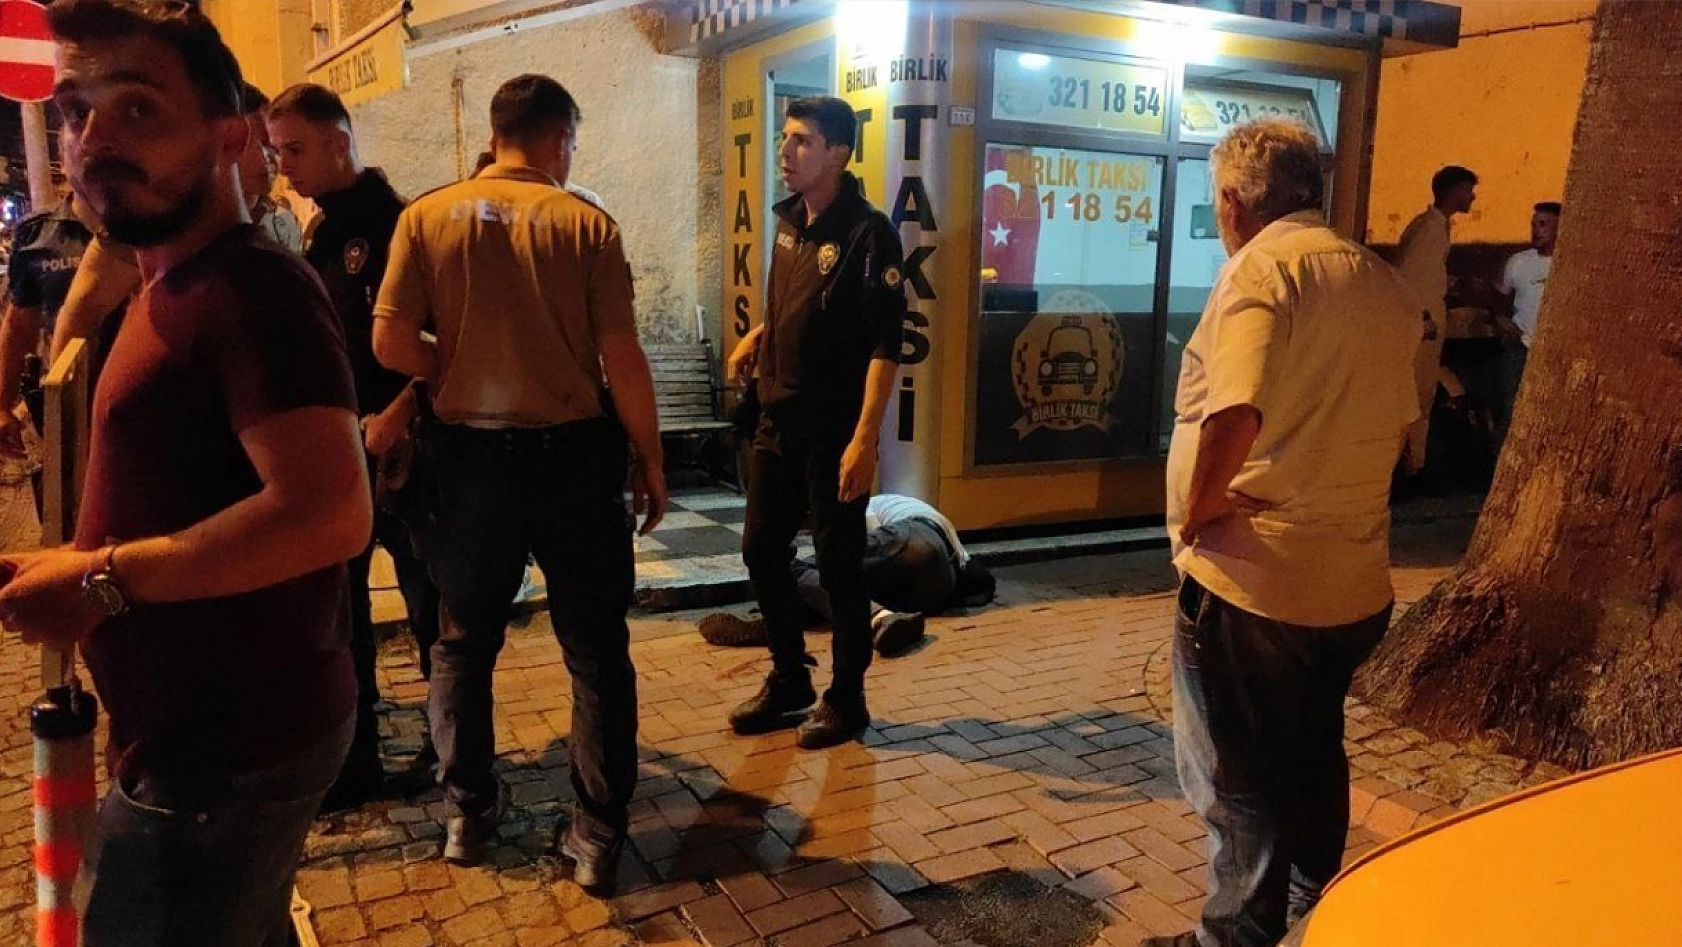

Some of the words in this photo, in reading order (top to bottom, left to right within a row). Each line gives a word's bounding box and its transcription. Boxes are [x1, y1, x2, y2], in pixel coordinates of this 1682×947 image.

[891, 54, 947, 82] BİRLİK
[1048, 75, 1090, 109] 321
[1101, 81, 1126, 113] 18
[1133, 84, 1160, 117] 54
[1068, 192, 1101, 222] 18
[1113, 195, 1153, 224] 54
[734, 133, 752, 338] TAKS
